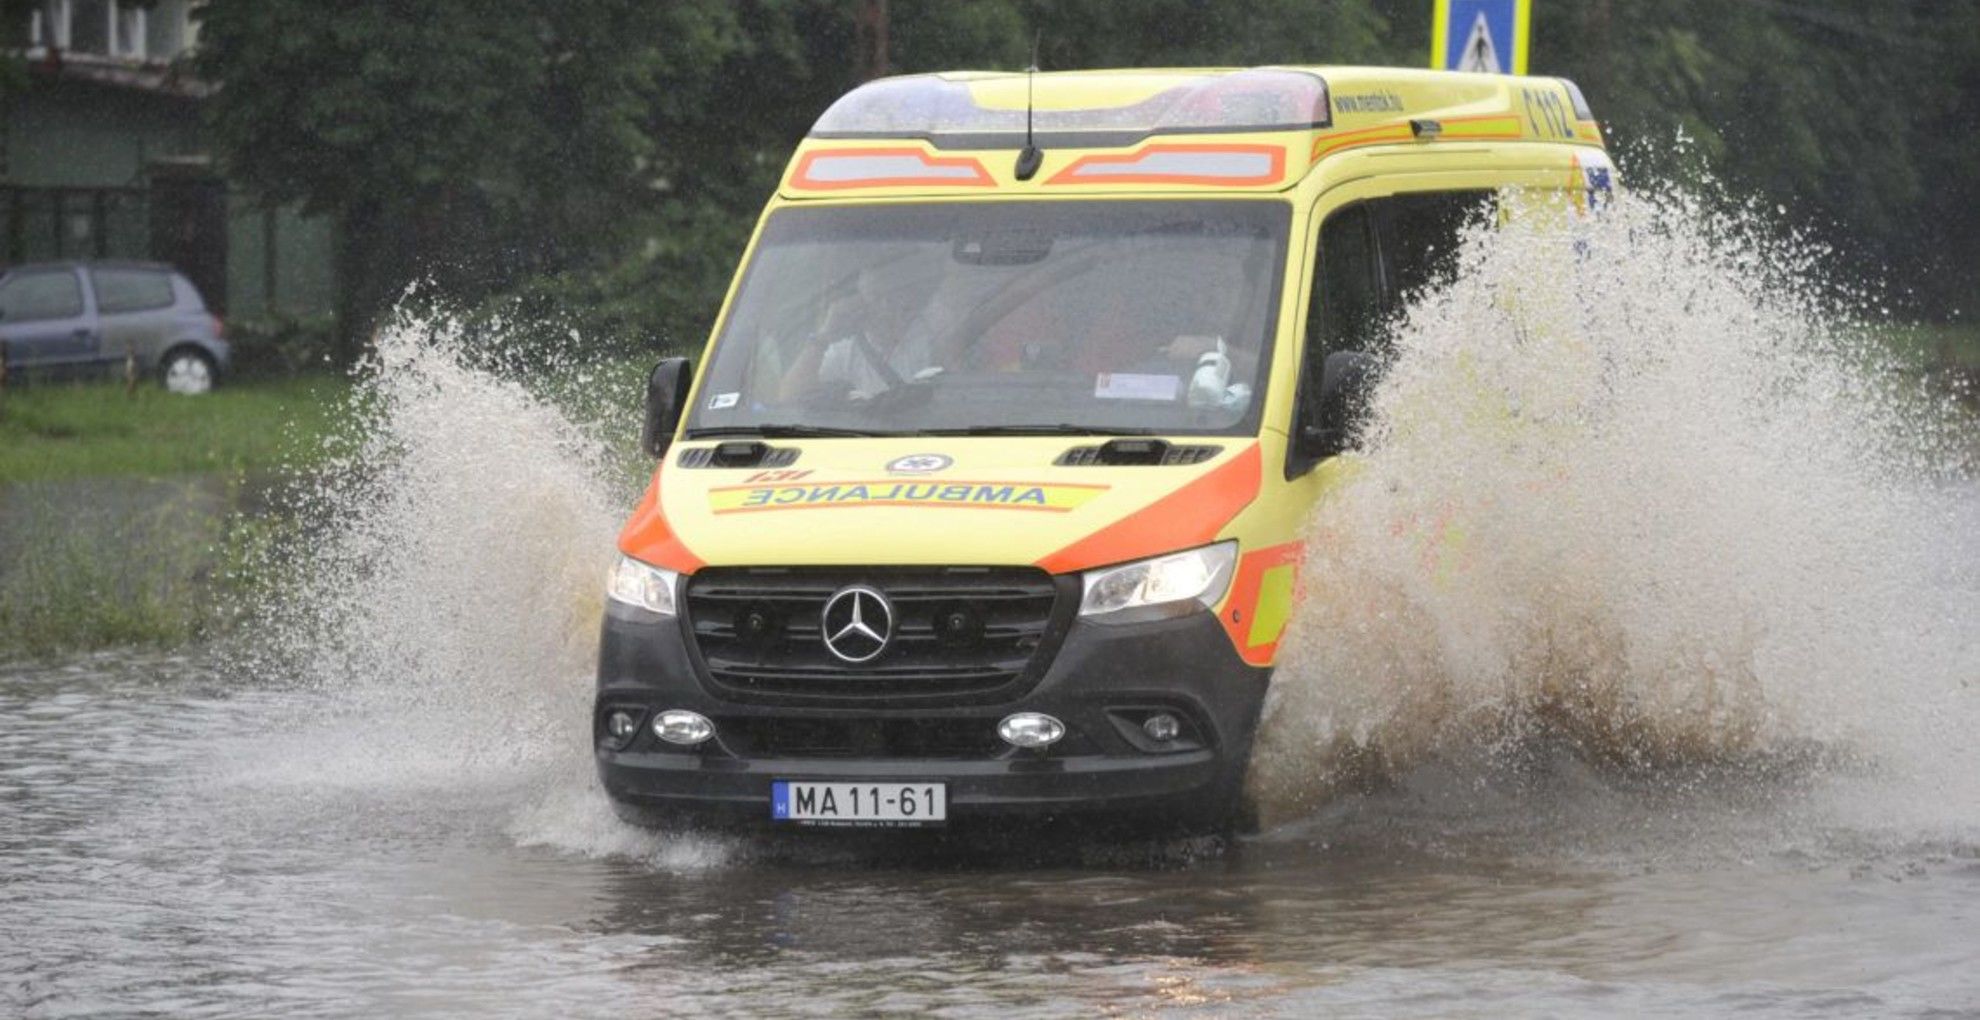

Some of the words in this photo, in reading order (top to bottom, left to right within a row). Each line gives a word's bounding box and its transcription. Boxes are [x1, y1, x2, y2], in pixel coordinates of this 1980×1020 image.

[777, 803, 786, 814] H
[796, 786, 838, 816] MA
[850, 786, 934, 816] 11-61
